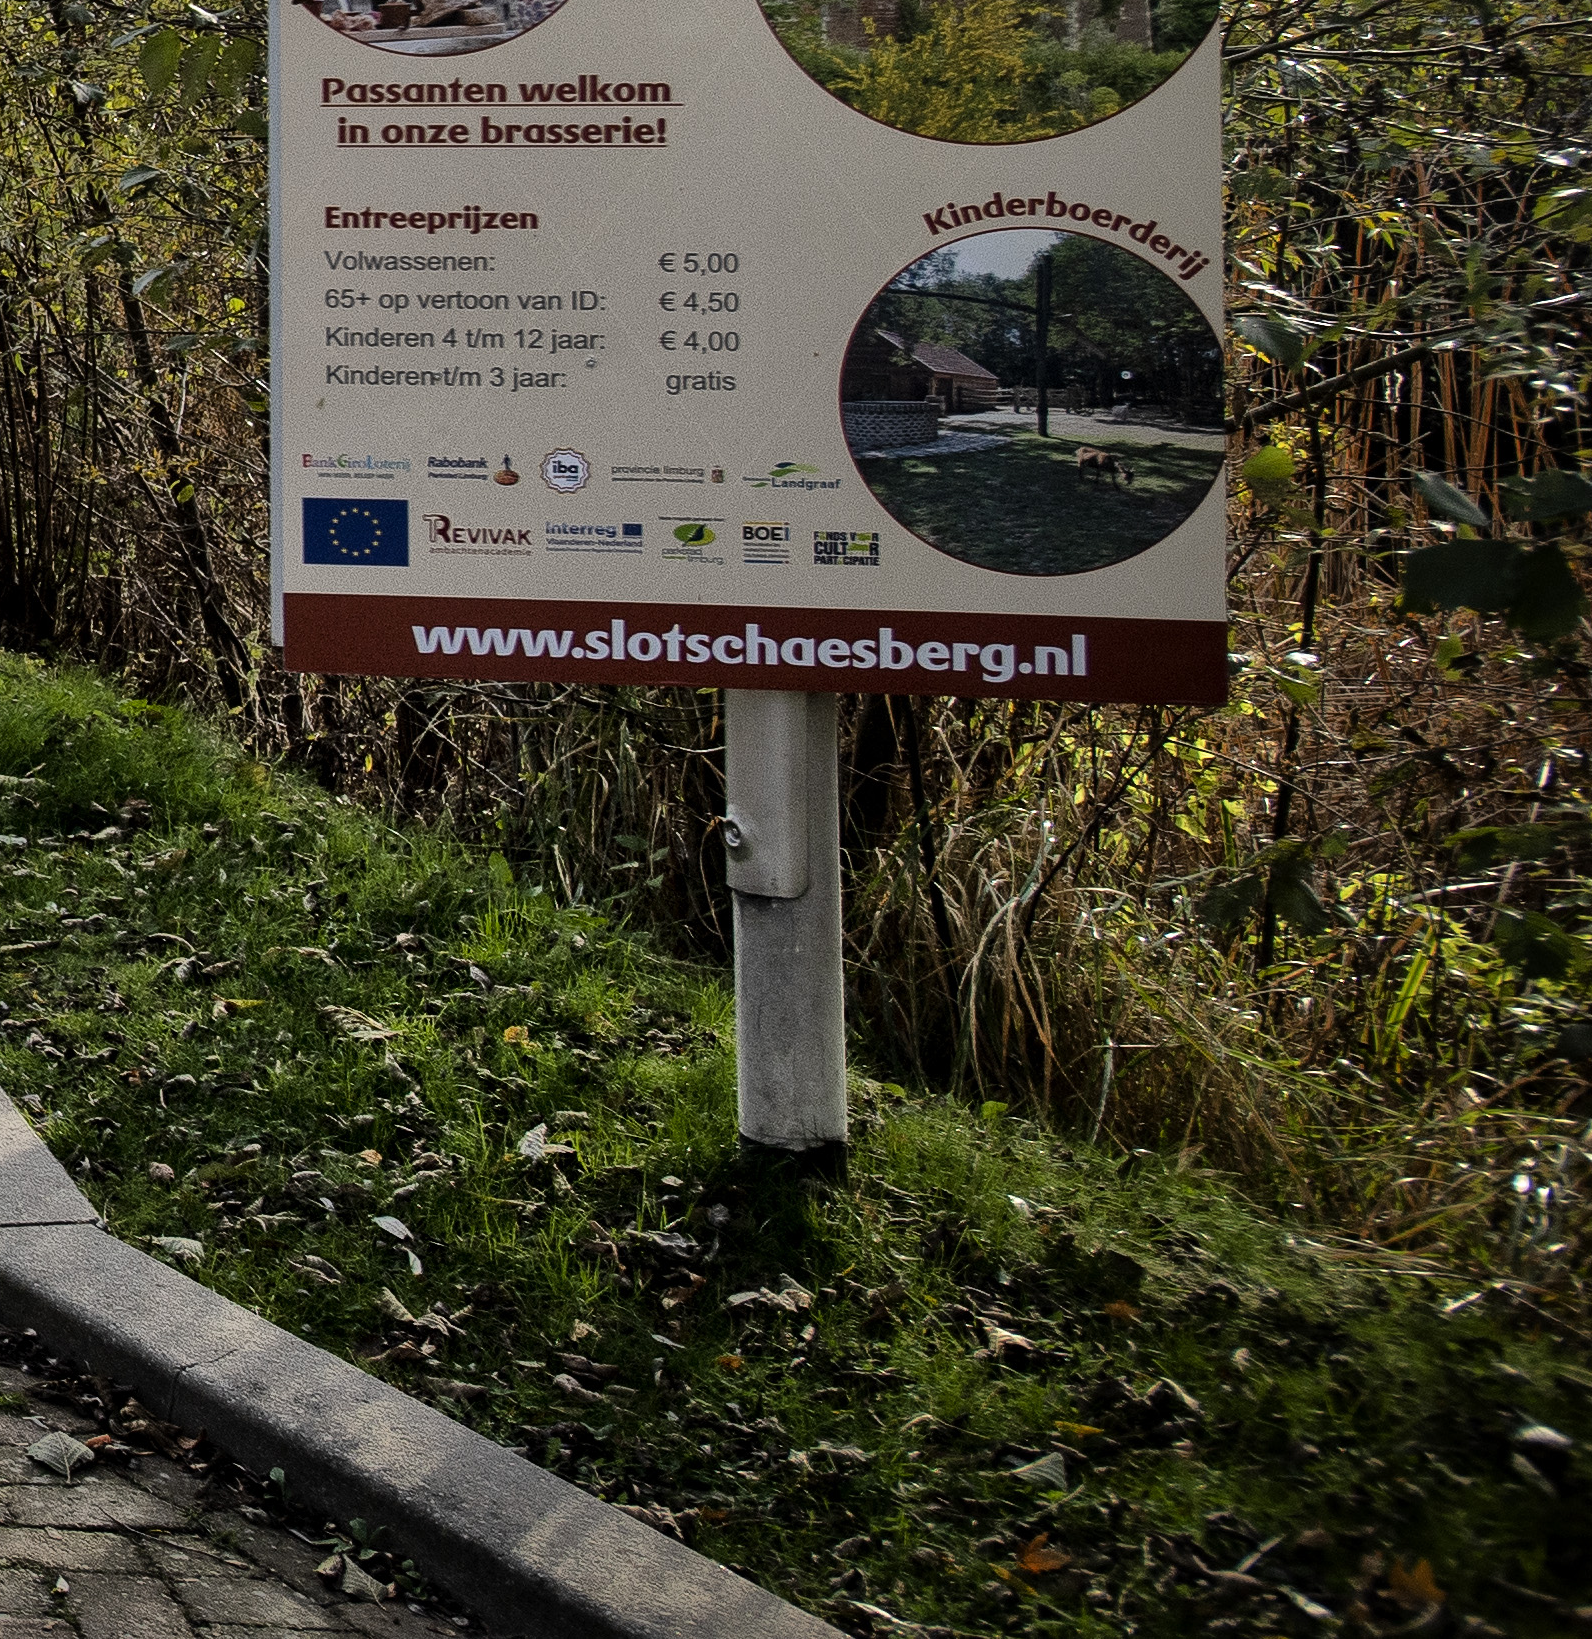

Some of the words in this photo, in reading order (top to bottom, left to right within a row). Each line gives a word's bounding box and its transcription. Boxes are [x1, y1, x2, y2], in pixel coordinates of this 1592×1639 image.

[321, 76, 508, 104] Passanten
[518, 74, 672, 104] welkom
[337, 117, 369, 145] in
[381, 123, 470, 145] onze
[481, 116, 667, 145] brasserie!
[324, 205, 539, 234] Entreeprijzen
[922, 191, 1210, 281] Kinderboerderij
[324, 251, 496, 272] Volwassenen:
[658, 252, 676, 273] €
[682, 252, 739, 276] 5,00
[324, 289, 371, 309] 65+
[379, 294, 409, 314] op
[417, 291, 509, 311] vertoon
[517, 295, 563, 311] van
[571, 291, 607, 311] ID:
[658, 291, 676, 312] €
[682, 291, 739, 315] 4,50
[325, 327, 435, 348] Kinderen
[442, 328, 458, 348] 4
[466, 328, 505, 348] t/m
[514, 328, 543, 349] 12
[549, 329, 606, 354] jaar:
[658, 330, 677, 351] €
[682, 330, 739, 354] 4,00
[325, 365, 435, 386] Kinderen
[443, 366, 482, 387] t/m
[490, 367, 504, 387] 3
[511, 368, 567, 392] jaar:
[666, 371, 736, 395] gratis
[302, 453, 411, 472] BankGiroLoterij
[428, 456, 489, 469] Rabobank
[552, 460, 579, 474] iba
[772, 477, 841, 491] Landgraaf
[813, 530, 847, 541] FNDS
[850, 531, 879, 542] VR
[813, 541, 879, 556] CULTR
[813, 555, 880, 566] PARTCIPATIE
[412, 618, 1088, 684] www.slotschaesberg.nl
